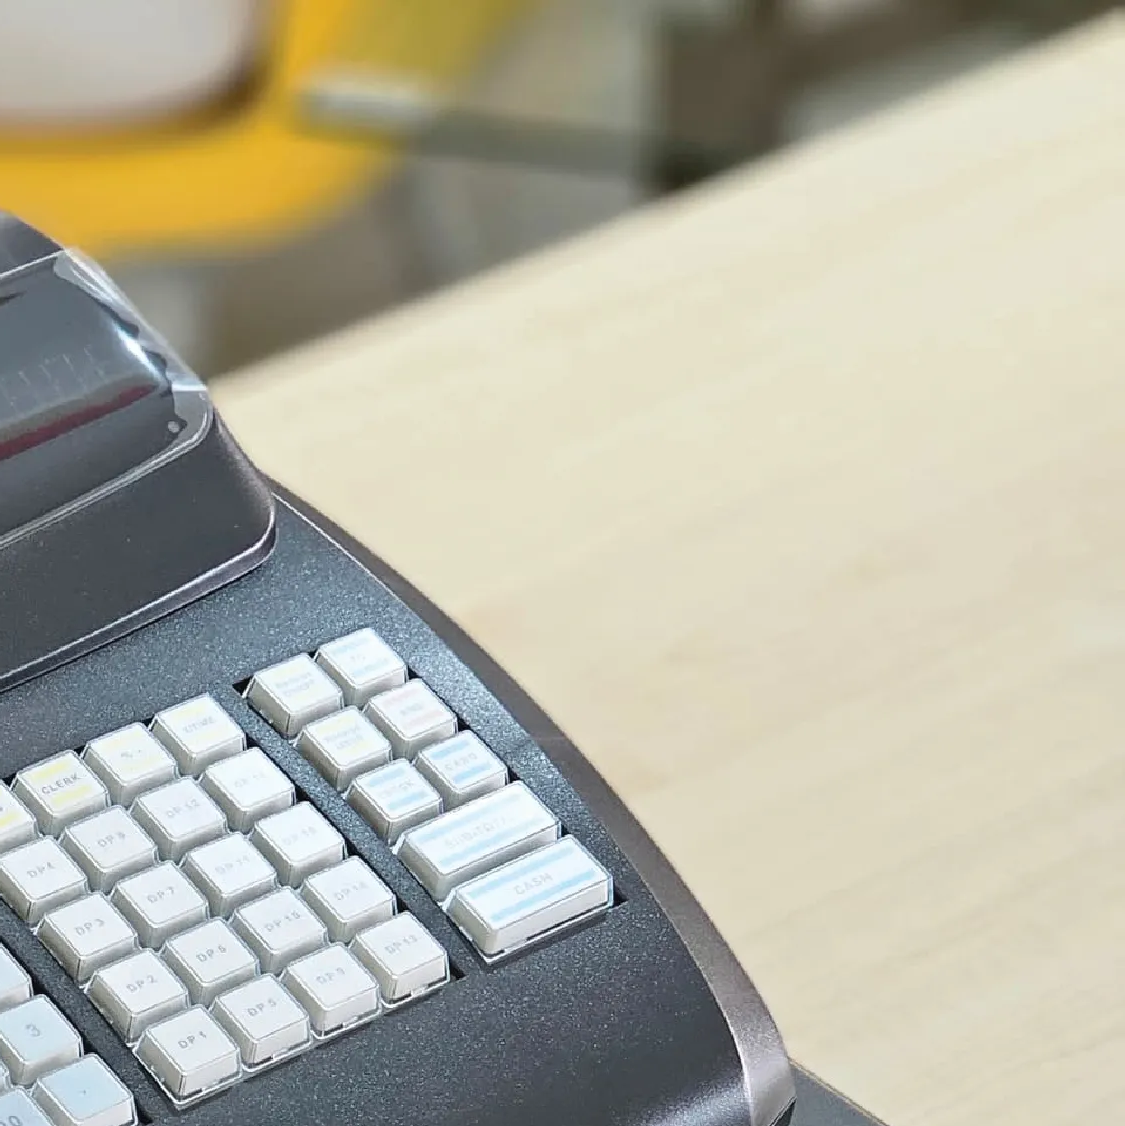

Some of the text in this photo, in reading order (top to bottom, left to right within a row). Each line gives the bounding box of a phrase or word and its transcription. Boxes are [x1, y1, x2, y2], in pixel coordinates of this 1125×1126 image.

[41, 774, 79, 795] CLERK
[514, 872, 553, 895] CASH
[26, 1024, 41, 1037] 3
